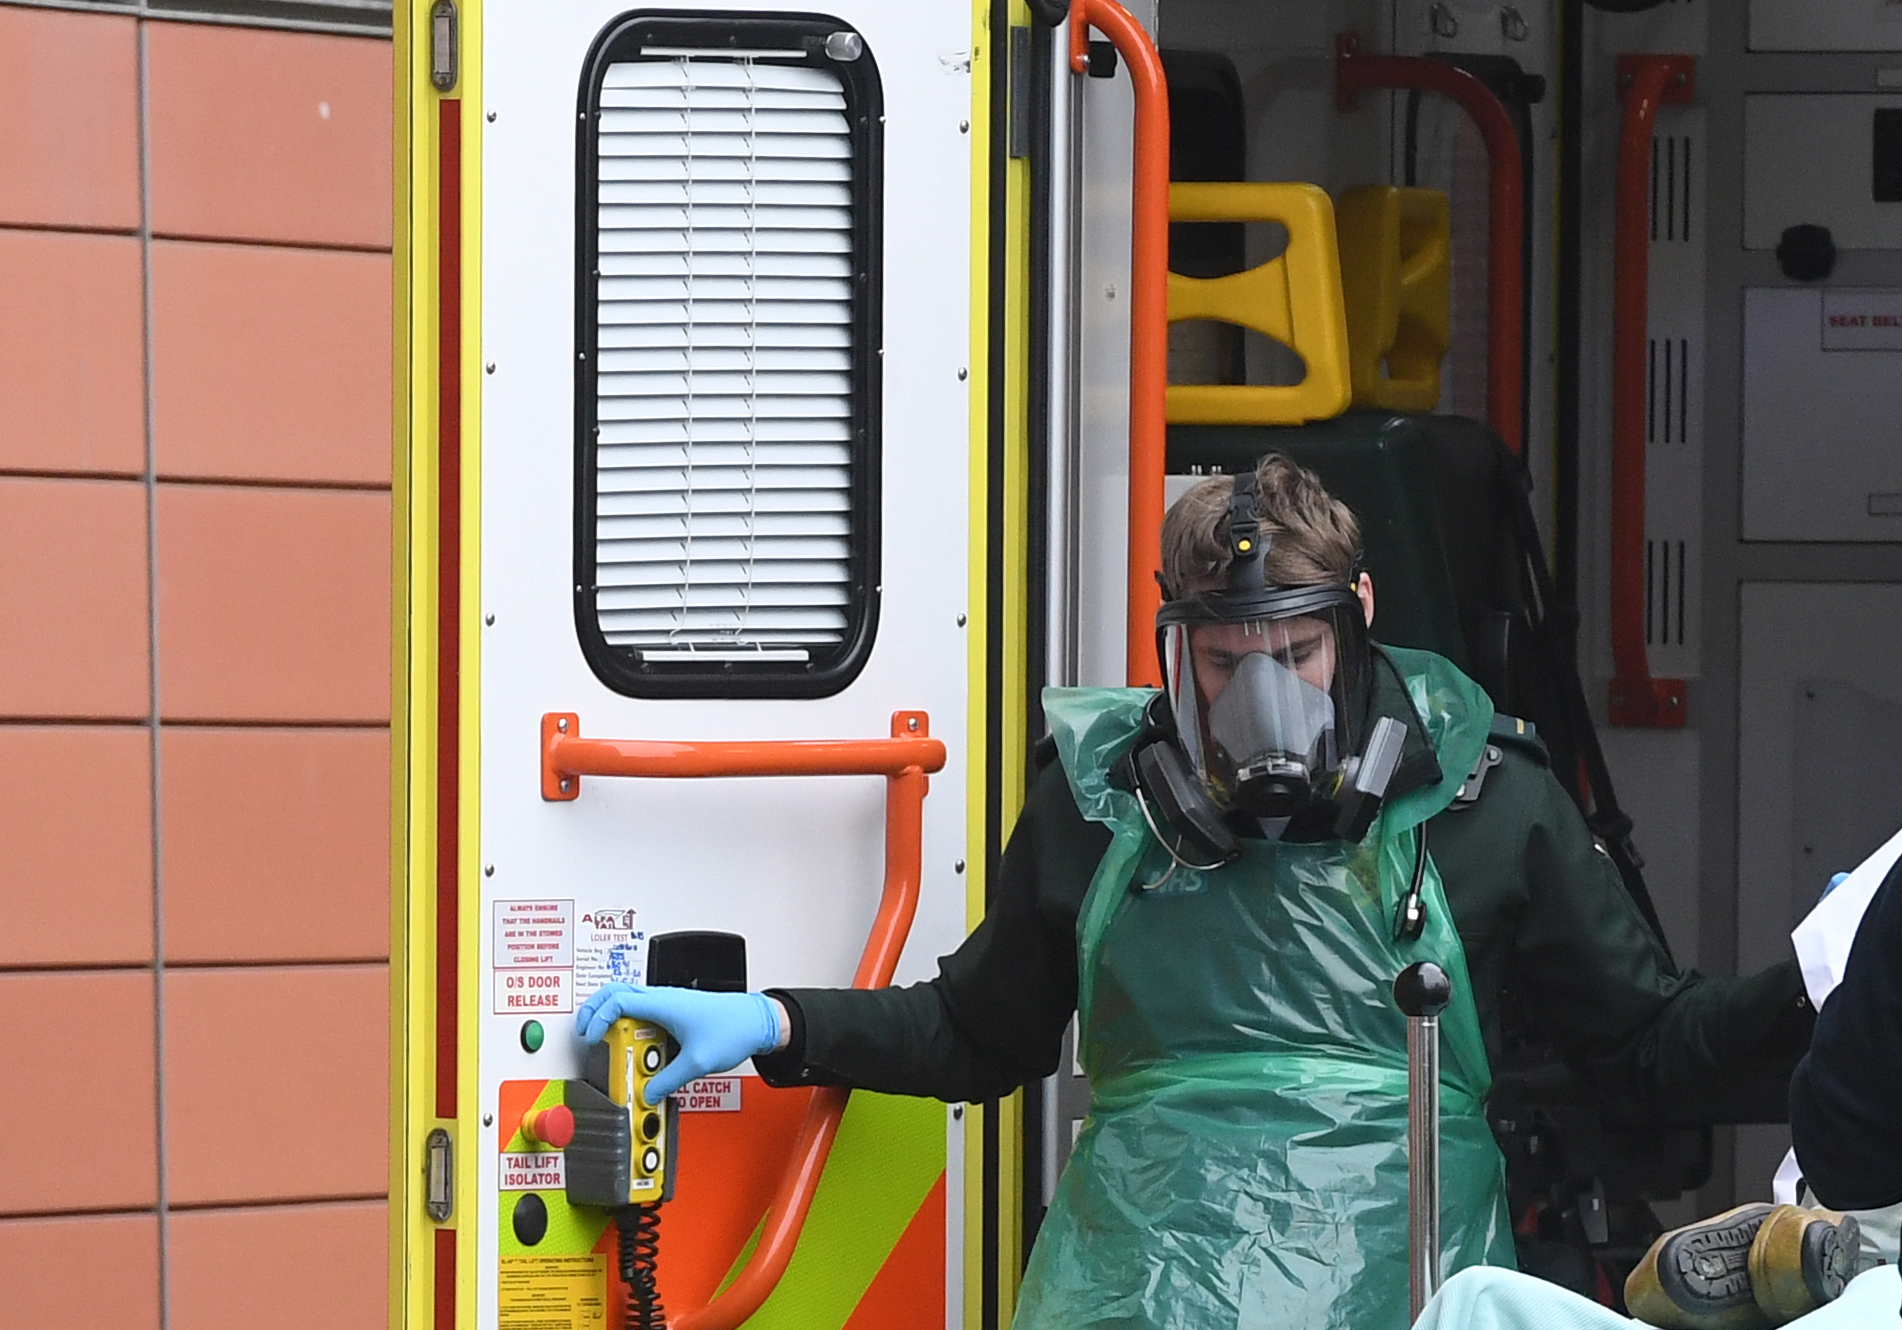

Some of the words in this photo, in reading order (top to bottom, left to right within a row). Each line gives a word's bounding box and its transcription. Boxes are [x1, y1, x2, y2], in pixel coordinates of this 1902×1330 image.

[1829, 315, 1867, 327] SEAT
[506, 976, 524, 988] O/S
[528, 975, 561, 988] DOOR
[507, 994, 559, 1007] RELEASE
[693, 1081, 731, 1094] CATCH
[690, 1096, 720, 1108] OPEN
[506, 1156, 531, 1169] TAIL
[534, 1156, 559, 1169] LIFT
[504, 1173, 561, 1186] ISOLATOR
